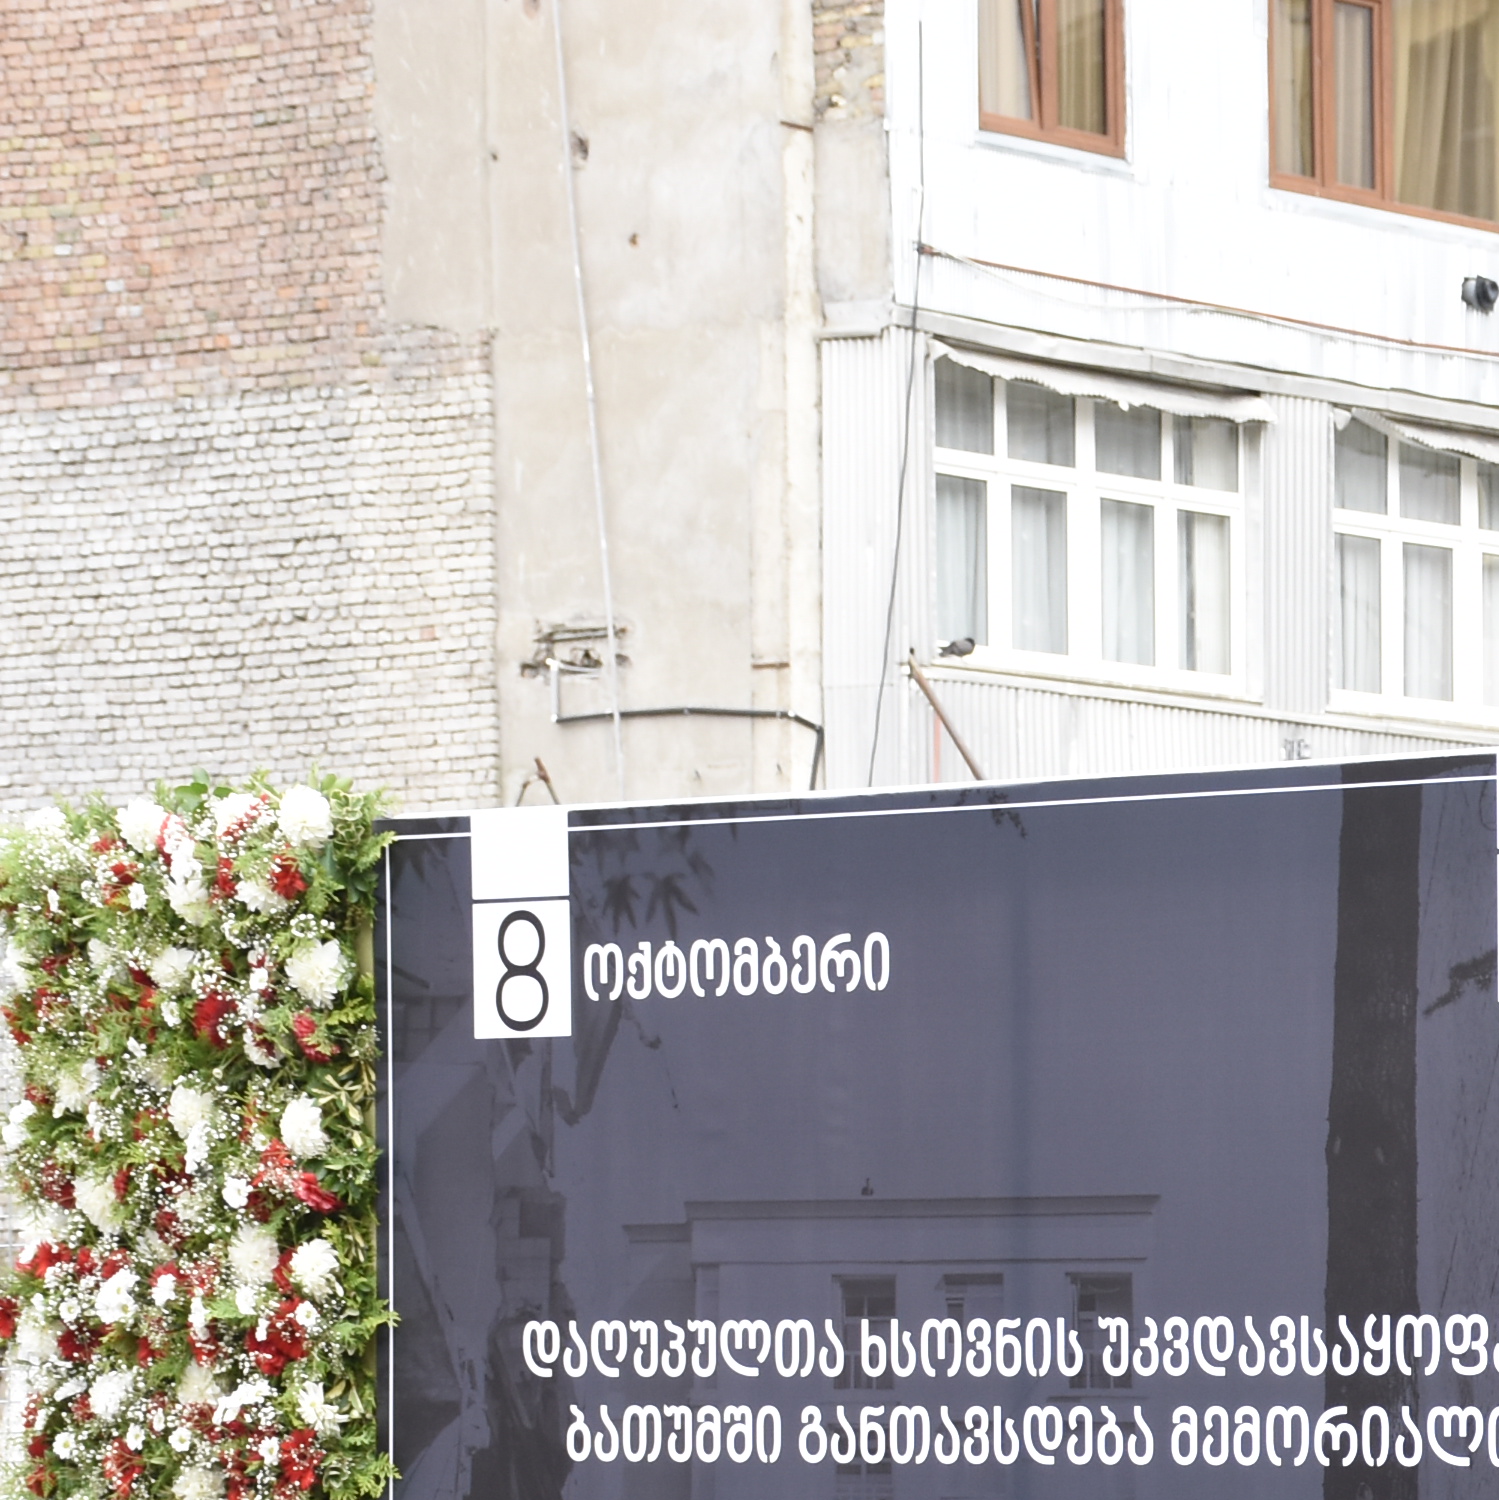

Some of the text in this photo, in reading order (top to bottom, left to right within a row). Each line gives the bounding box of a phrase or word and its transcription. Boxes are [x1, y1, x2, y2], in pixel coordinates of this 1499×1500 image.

[495, 910, 890, 1032] 8 ოქტომბერი
[522, 1318, 845, 1378] დაღუპულთა
[860, 1316, 1084, 1378] ხსოვნის
[566, 1404, 782, 1464] ბათუმში
[798, 1404, 1154, 1466] განთავსდება
